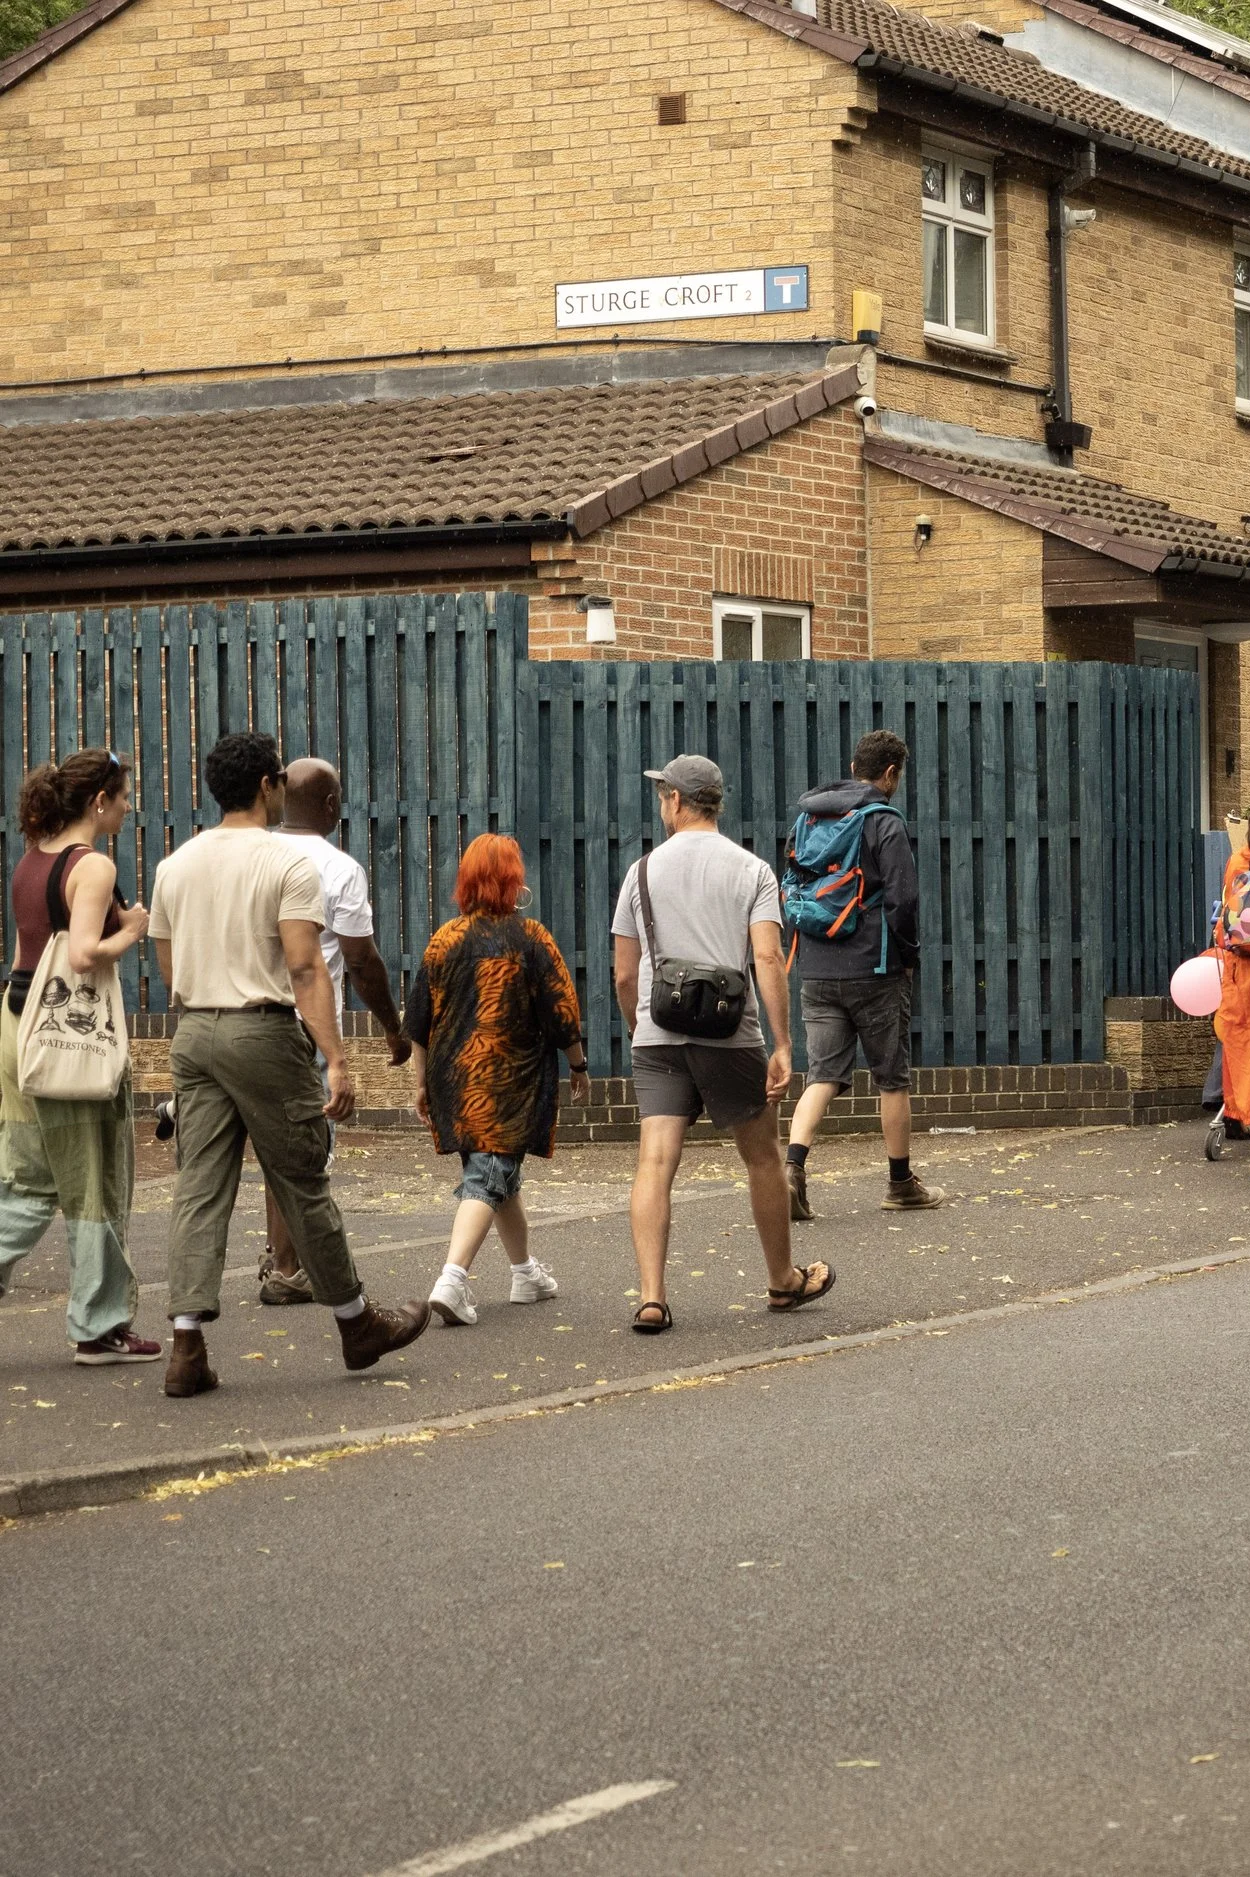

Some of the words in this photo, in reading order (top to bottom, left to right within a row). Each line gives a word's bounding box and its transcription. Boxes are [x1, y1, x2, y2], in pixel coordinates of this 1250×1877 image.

[565, 290, 650, 314] STURGE
[664, 283, 738, 306] CROFT
[745, 289, 752, 301] 2
[39, 1038, 107, 1057] WATERSTONES
